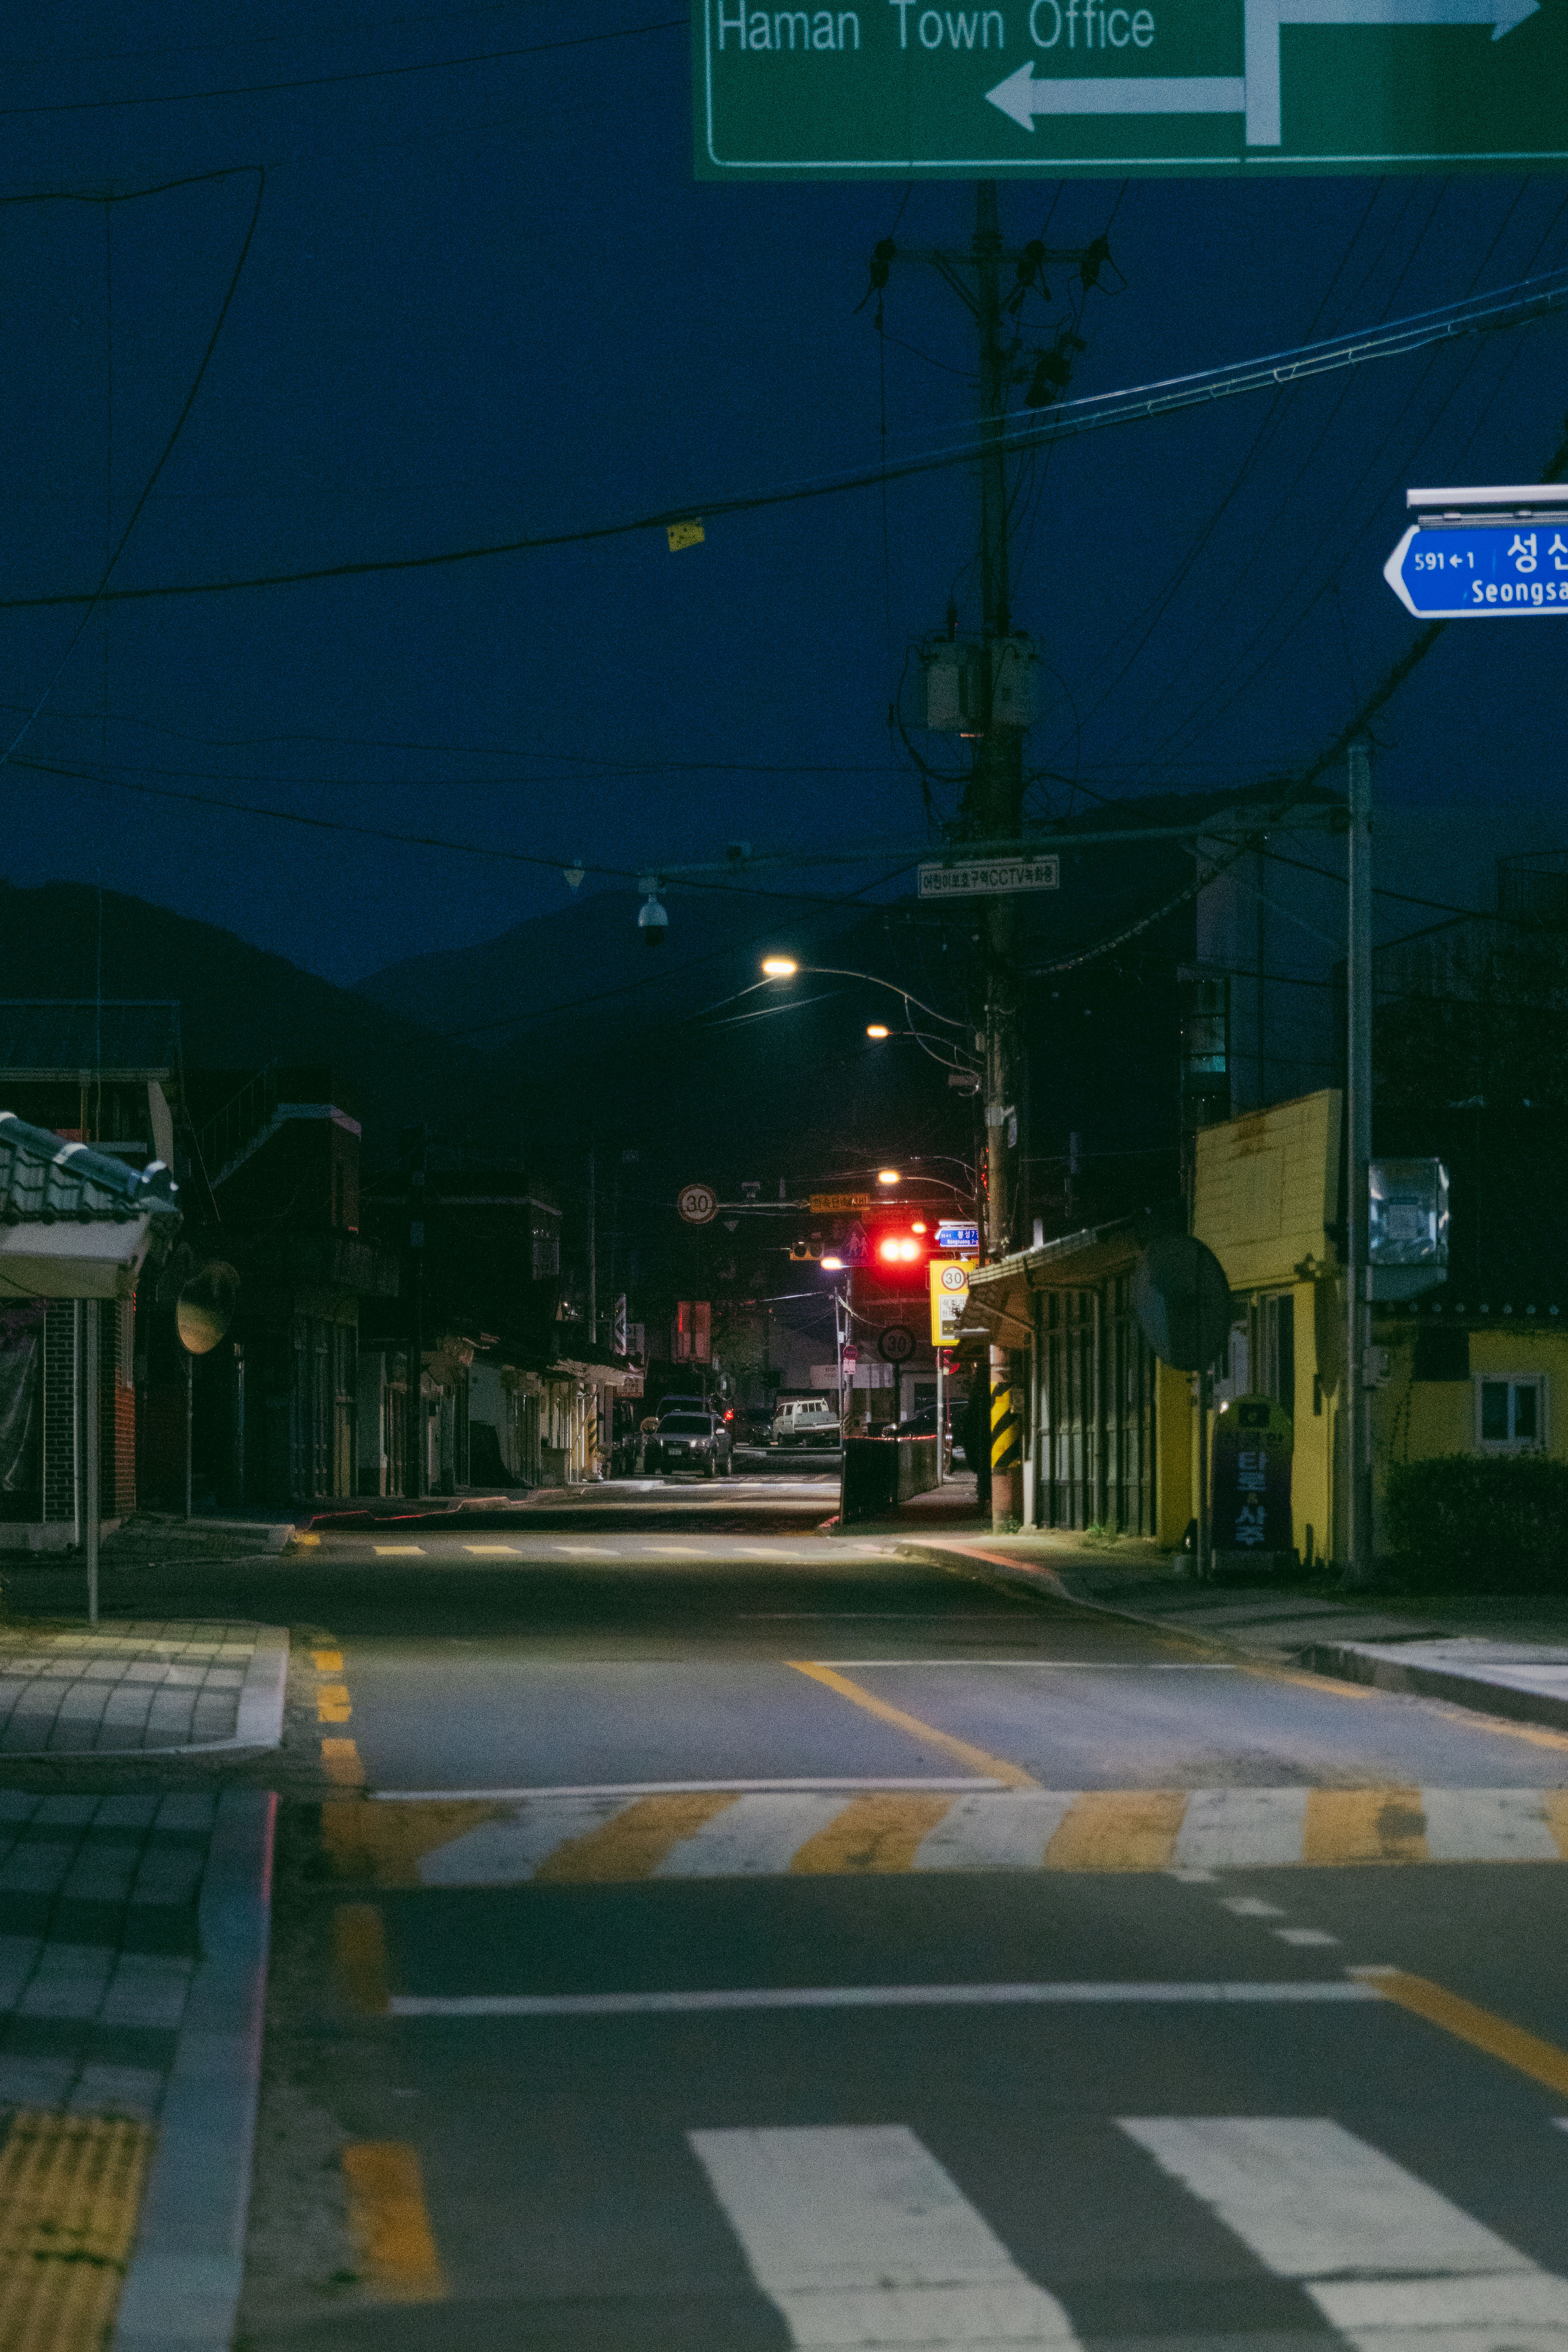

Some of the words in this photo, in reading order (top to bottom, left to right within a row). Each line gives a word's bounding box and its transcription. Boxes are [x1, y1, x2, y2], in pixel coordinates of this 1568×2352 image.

[718, 0, 859, 50] Haman
[890, 0, 1004, 50] Town
[1029, 0, 1155, 49] Office
[1472, 580, 1568, 606] Seongsa
[686, 1194, 708, 1213] 30
[946, 1272, 961, 1284] 30
[888, 1336, 905, 1353] 30
